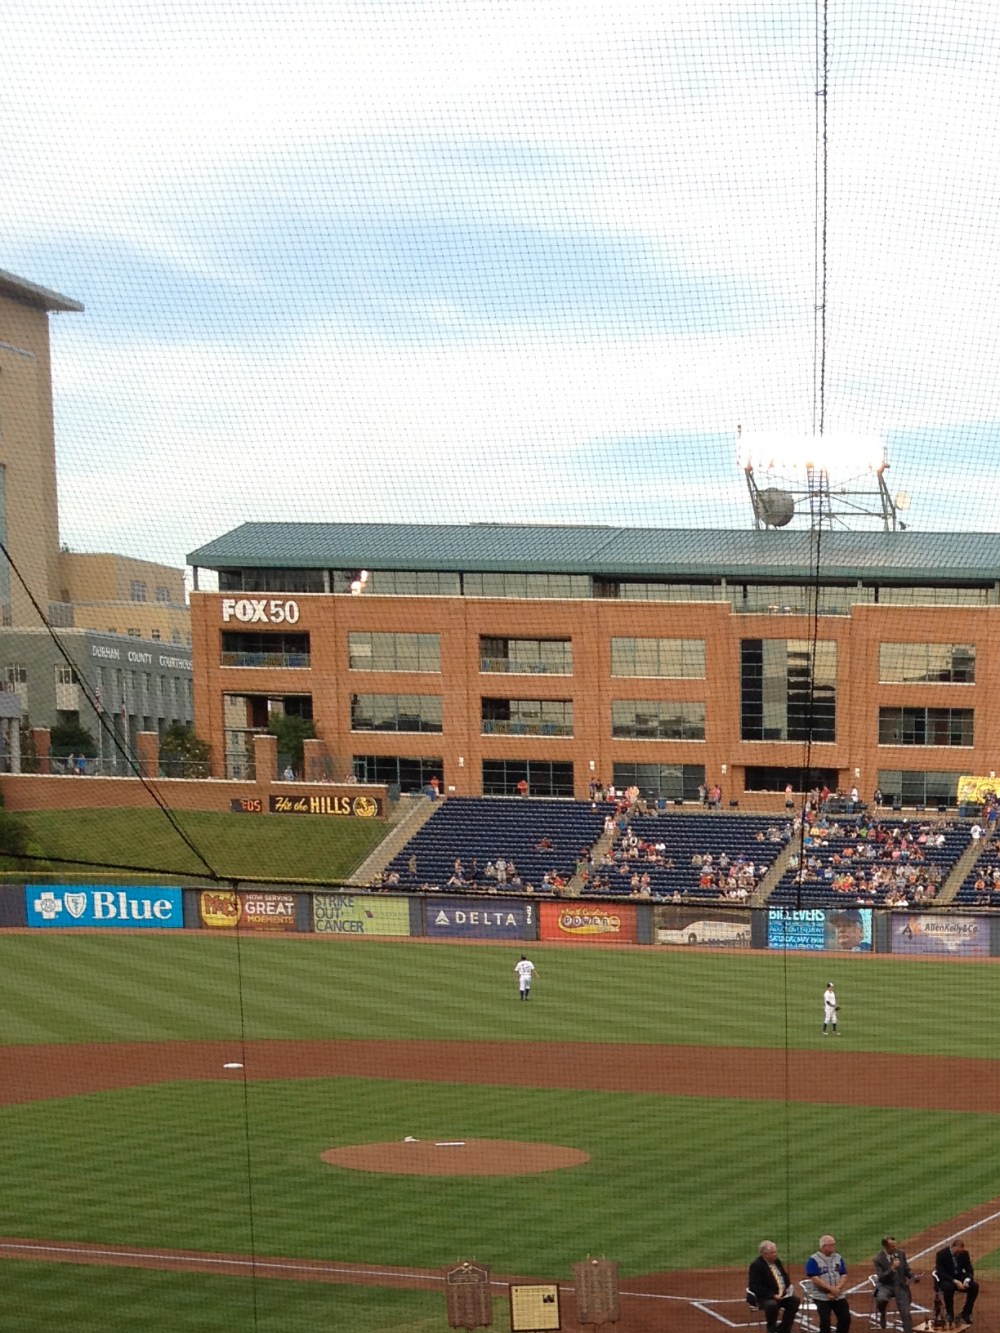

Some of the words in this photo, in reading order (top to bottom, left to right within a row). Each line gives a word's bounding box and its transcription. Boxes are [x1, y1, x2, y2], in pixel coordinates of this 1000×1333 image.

[92, 645, 120, 660] DURHAM
[128, 651, 152, 665] COUNTY
[159, 656, 194, 671] COURTHOUS
[310, 796, 350, 815] HILLS
[91, 890, 173, 920] Blue
[244, 902, 295, 915] GREAT
[315, 895, 355, 908] STRIKE
[315, 919, 365, 933] CANCER
[455, 911, 517, 926] DELTA
